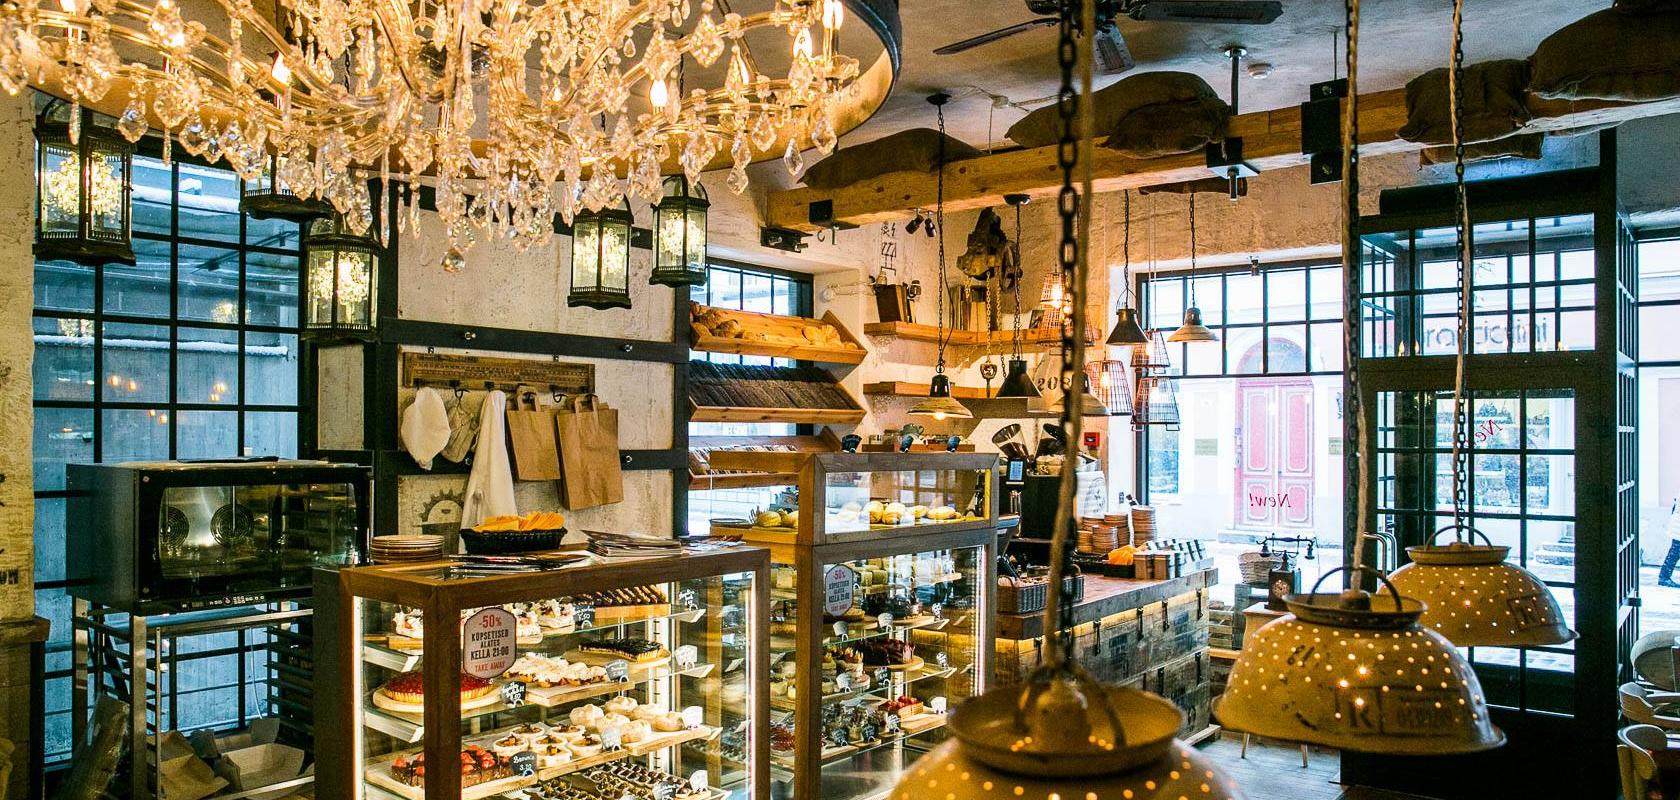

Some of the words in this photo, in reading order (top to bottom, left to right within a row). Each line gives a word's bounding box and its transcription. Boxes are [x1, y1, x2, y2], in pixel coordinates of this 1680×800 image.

[478, 614, 502, 628] -50%
[480, 639, 501, 648] ALATES
[471, 649, 491, 660] KELLA
[475, 663, 489, 672] TAKE
[490, 661, 506, 669] AWAY
